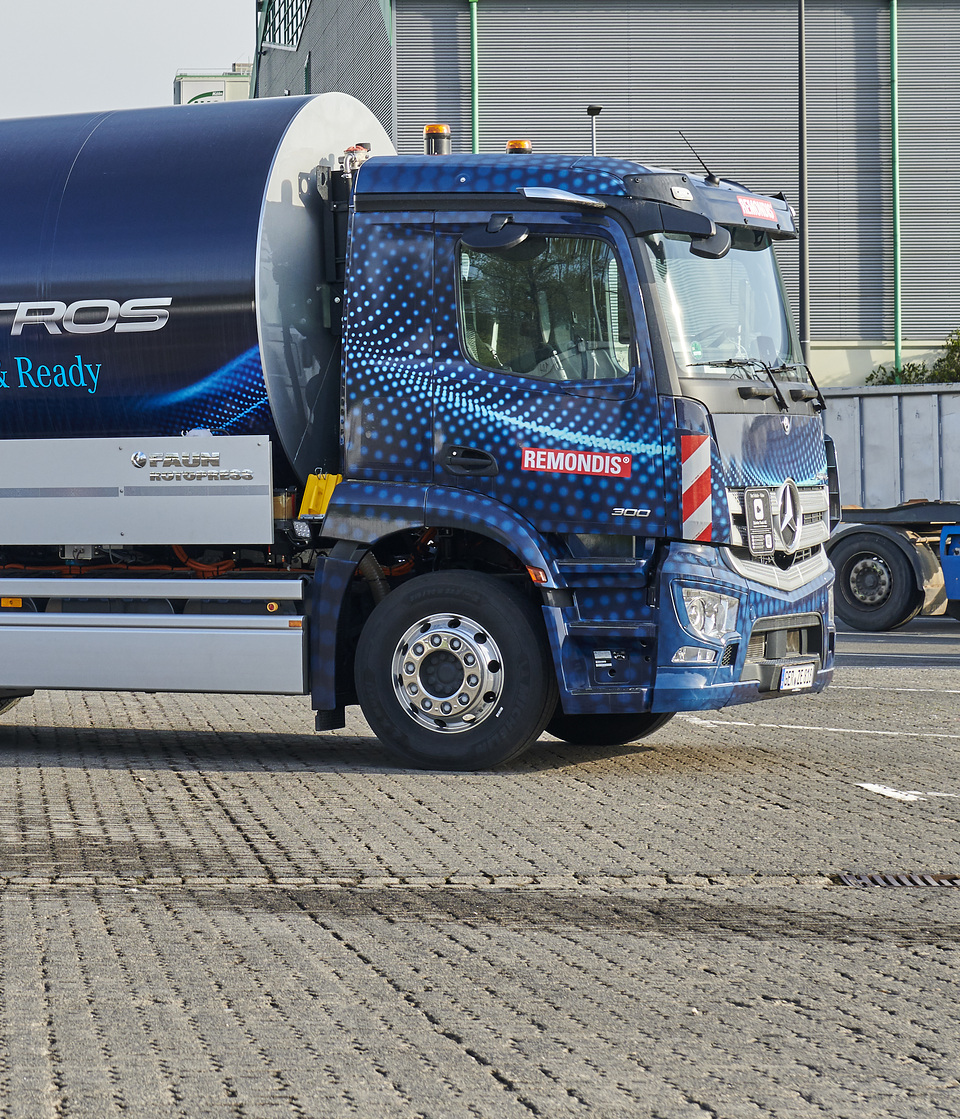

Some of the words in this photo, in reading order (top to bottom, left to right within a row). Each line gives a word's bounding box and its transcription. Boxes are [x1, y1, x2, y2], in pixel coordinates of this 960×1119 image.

[14, 354, 102, 394] Ready
[149, 451, 221, 468] FAUN
[149, 468, 254, 482] ROTOPRESS
[611, 507, 651, 518] 300
